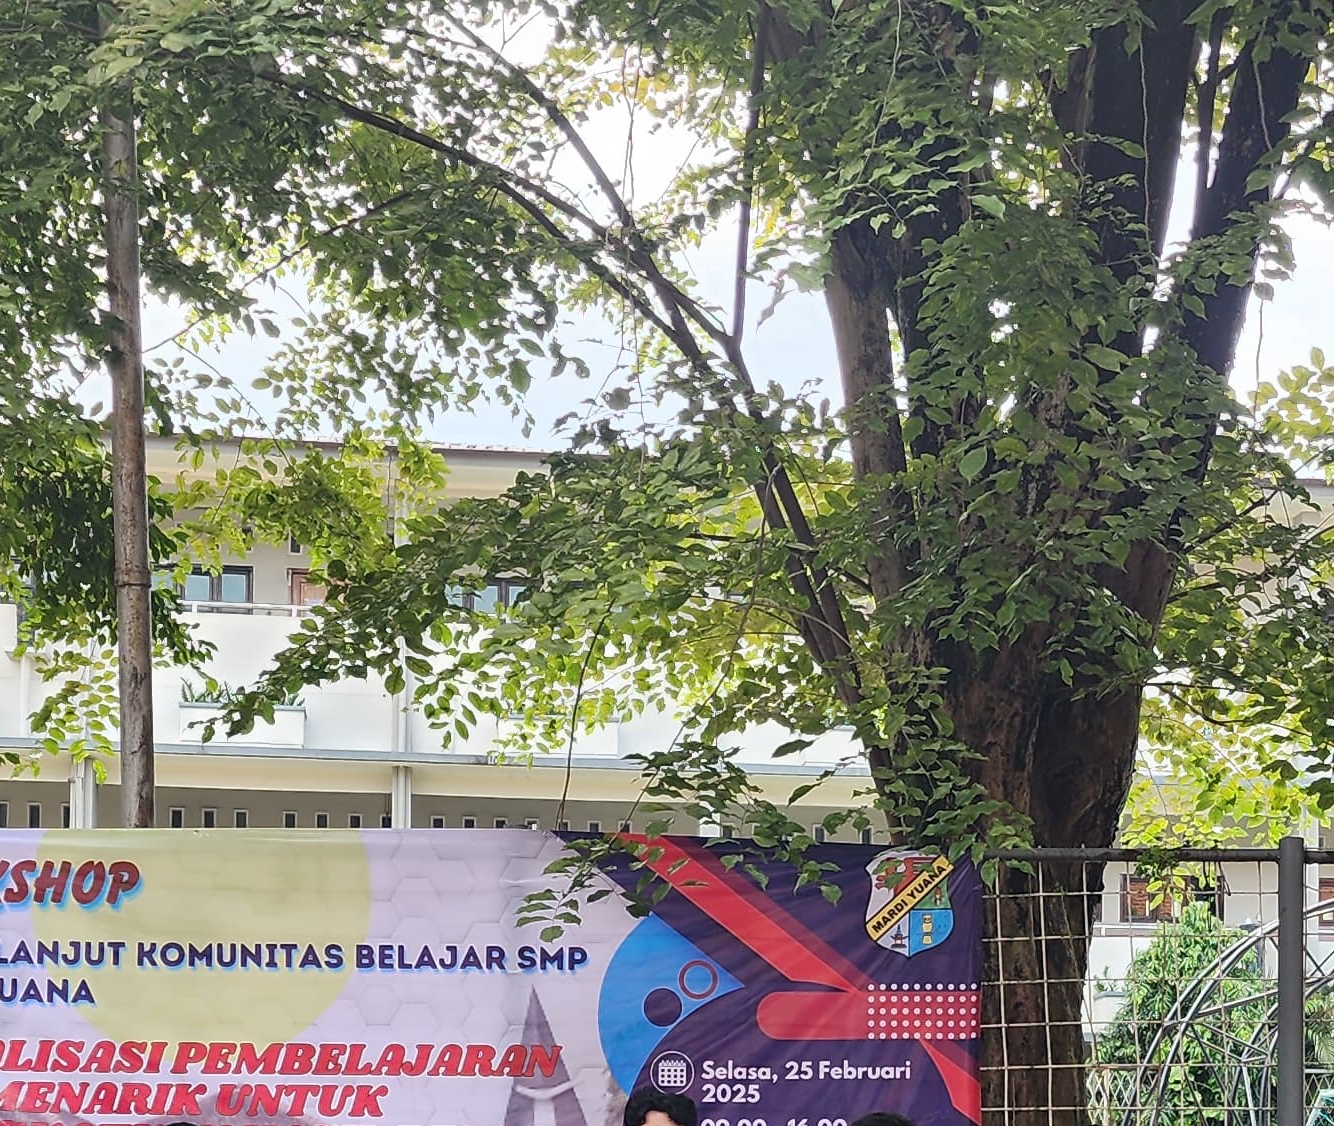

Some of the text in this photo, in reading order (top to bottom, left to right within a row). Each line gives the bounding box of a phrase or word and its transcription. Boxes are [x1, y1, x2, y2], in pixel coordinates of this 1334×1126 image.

[872, 865, 947, 933] MARDI YUANA
[137, 942, 344, 970] KOMUNITAS
[355, 944, 506, 970] BELAJAR
[518, 945, 588, 971] SMP
[170, 1043, 563, 1077] PEMBELAJARAN
[701, 1060, 911, 1083] Selasa, 25 Februari
[215, 1084, 389, 1117] UNTUK
[701, 1084, 760, 1103] 2025
